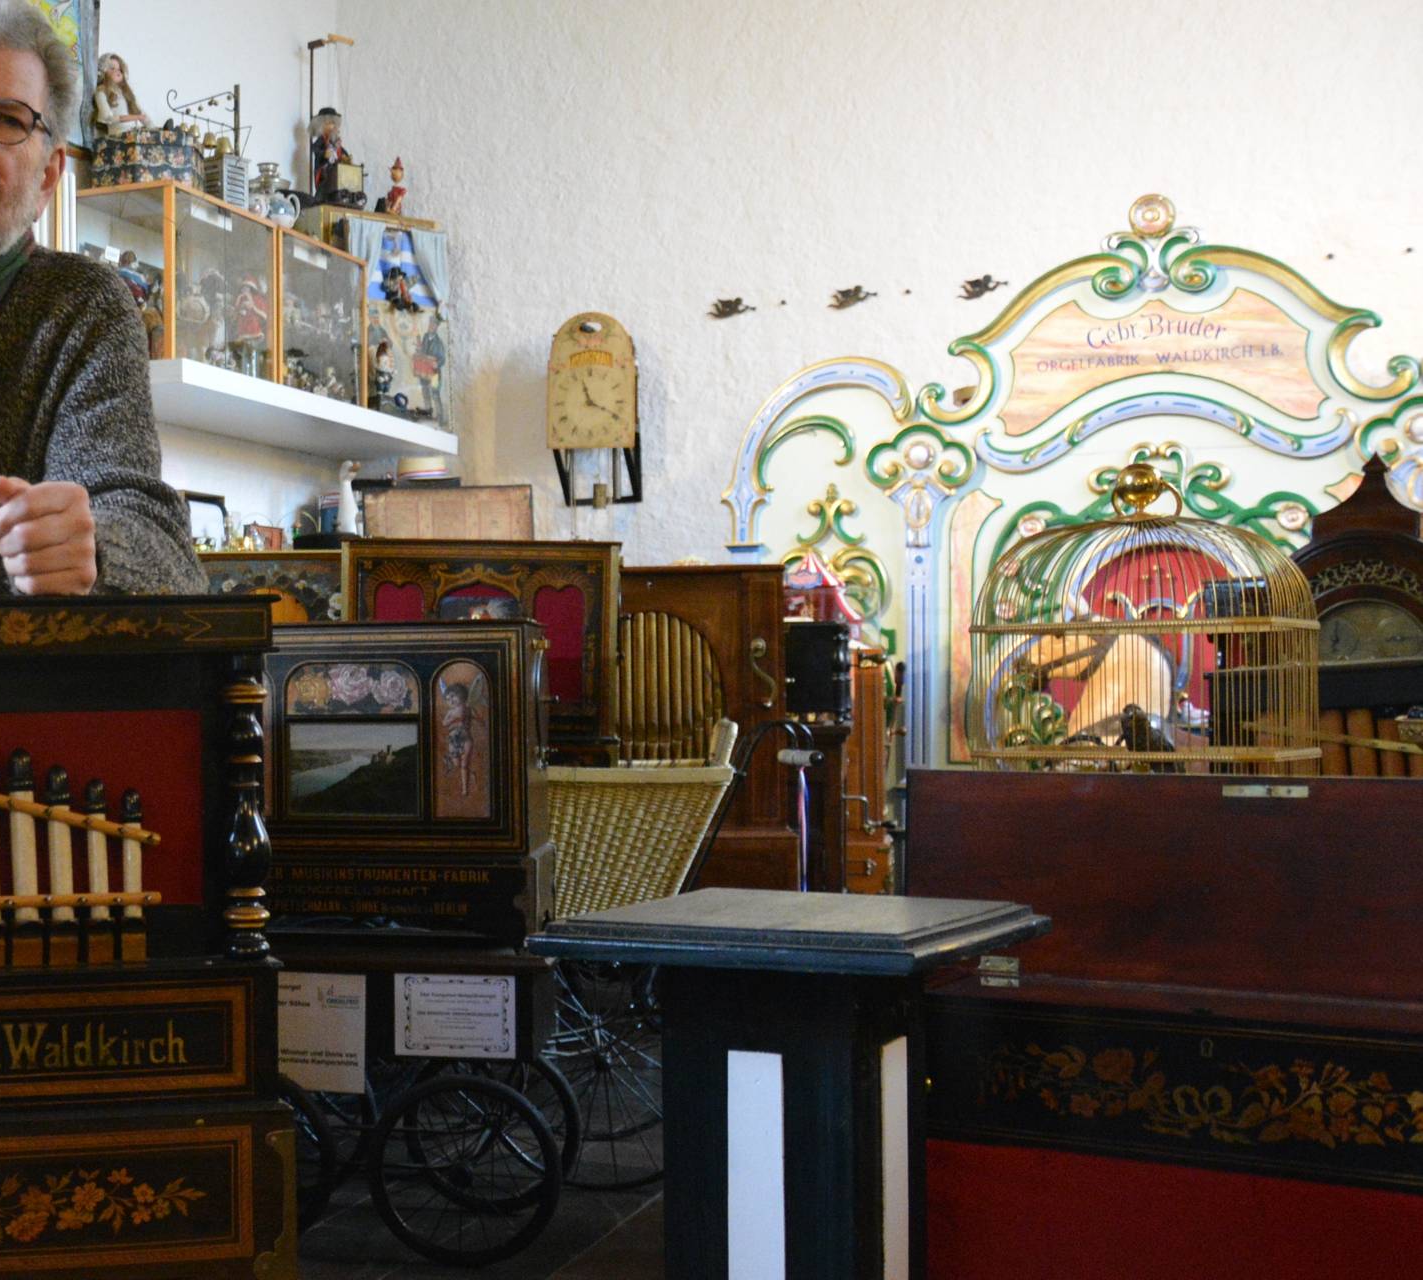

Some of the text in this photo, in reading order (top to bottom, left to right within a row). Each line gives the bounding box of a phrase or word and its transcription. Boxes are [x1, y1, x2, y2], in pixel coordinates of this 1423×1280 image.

[1140, 313, 1227, 340] Bruder
[1036, 355, 1140, 373] ORGELFABRIK
[1155, 344, 1253, 364] WALDKIRCH
[1, 1017, 189, 1071] Waldkirch
